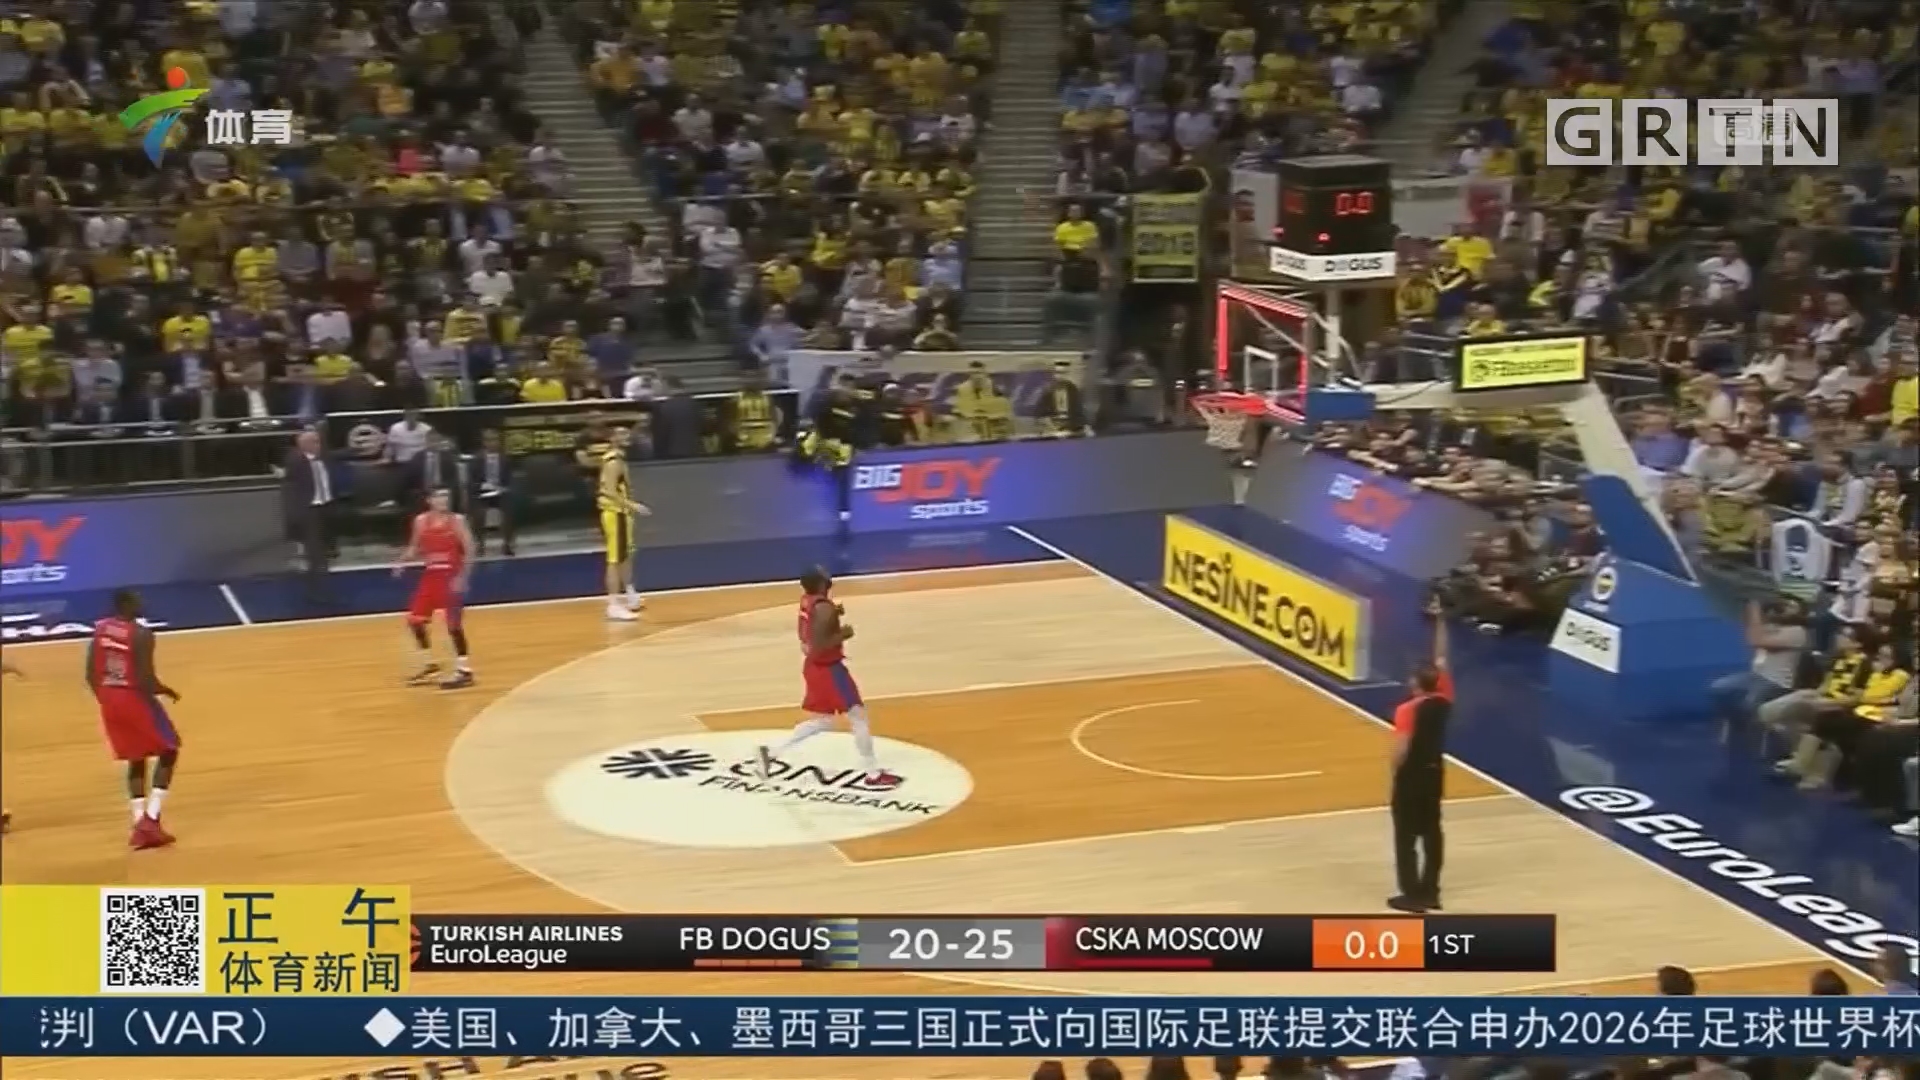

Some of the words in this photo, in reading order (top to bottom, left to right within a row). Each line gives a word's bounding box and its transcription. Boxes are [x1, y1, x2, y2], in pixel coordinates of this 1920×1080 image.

[852, 464, 903, 490] BIG
[873, 457, 1002, 503] JOY
[910, 498, 989, 520] sports
